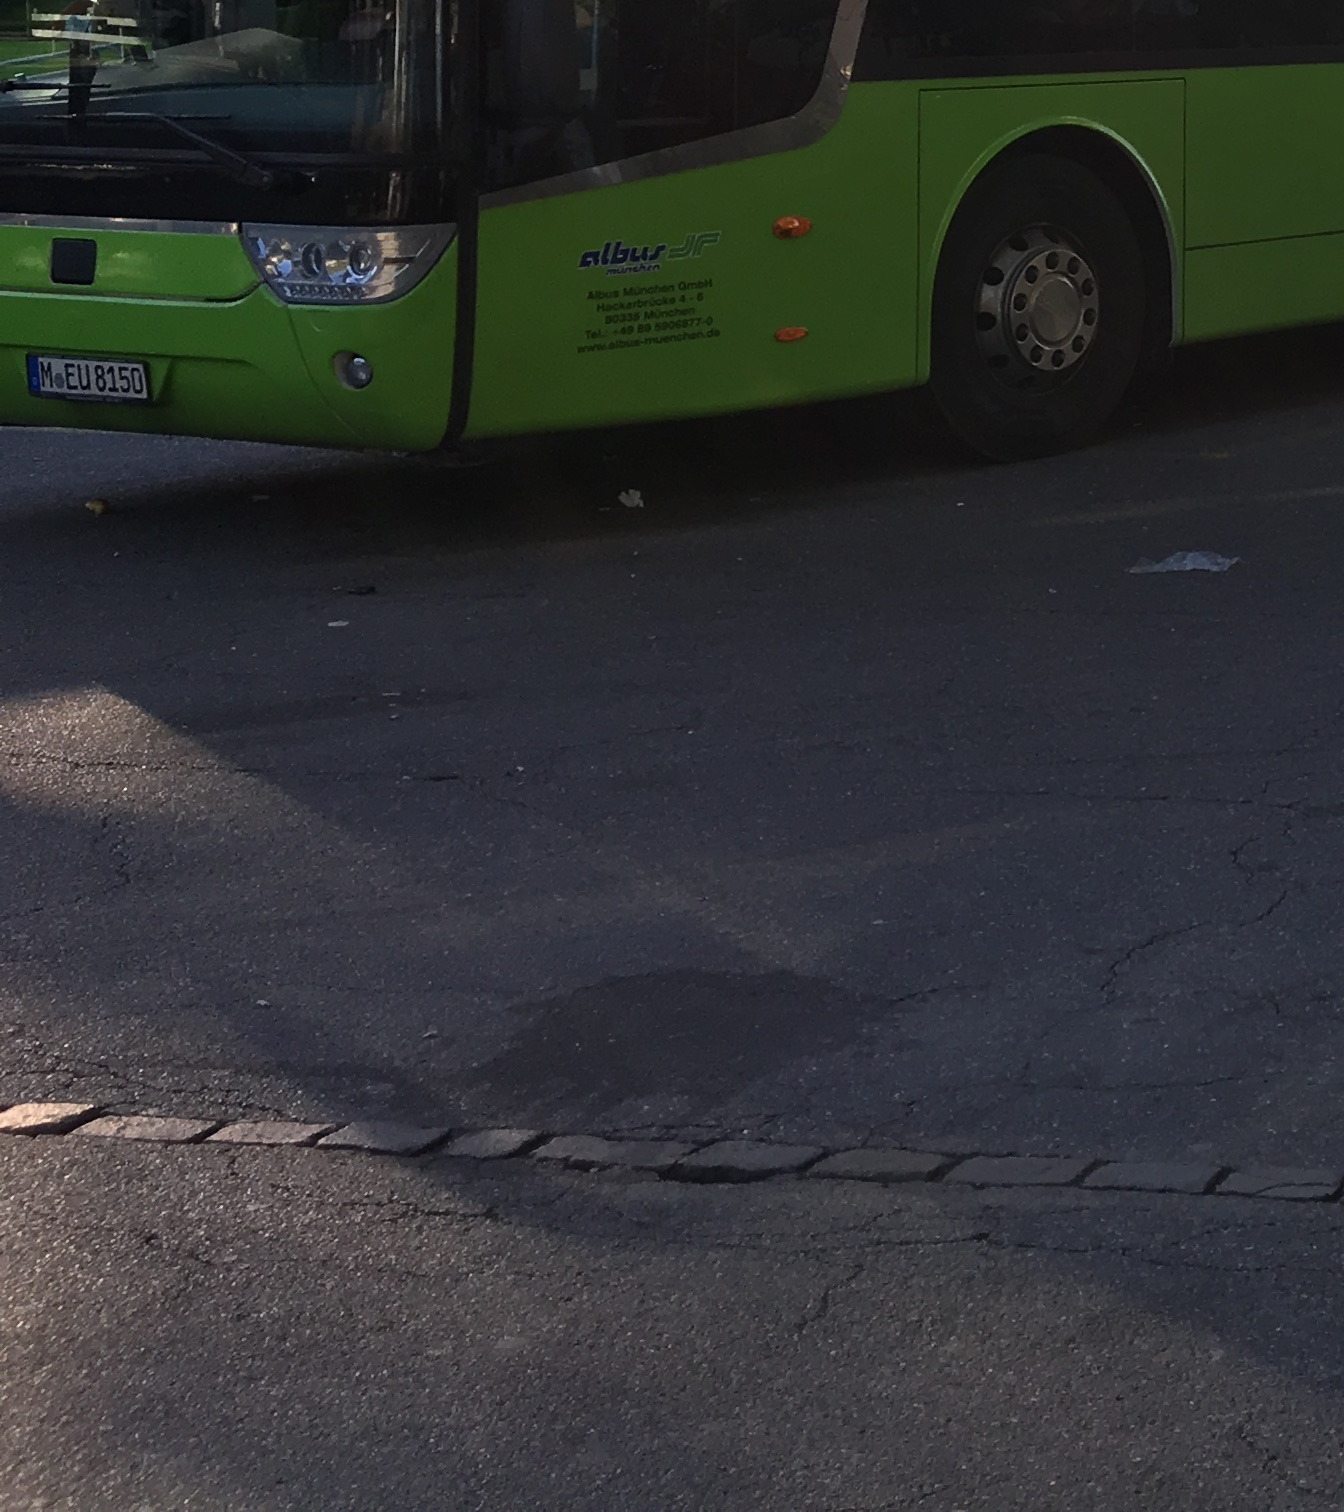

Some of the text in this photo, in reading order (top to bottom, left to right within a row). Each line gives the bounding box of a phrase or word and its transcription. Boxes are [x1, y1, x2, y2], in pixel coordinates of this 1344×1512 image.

[578, 240, 668, 269] albus
[586, 278, 713, 300] Albus München GmbH
[596, 296, 676, 313] Hackerbrücke
[644, 306, 696, 320] München
[39, 361, 144, 394] M EU 8150
